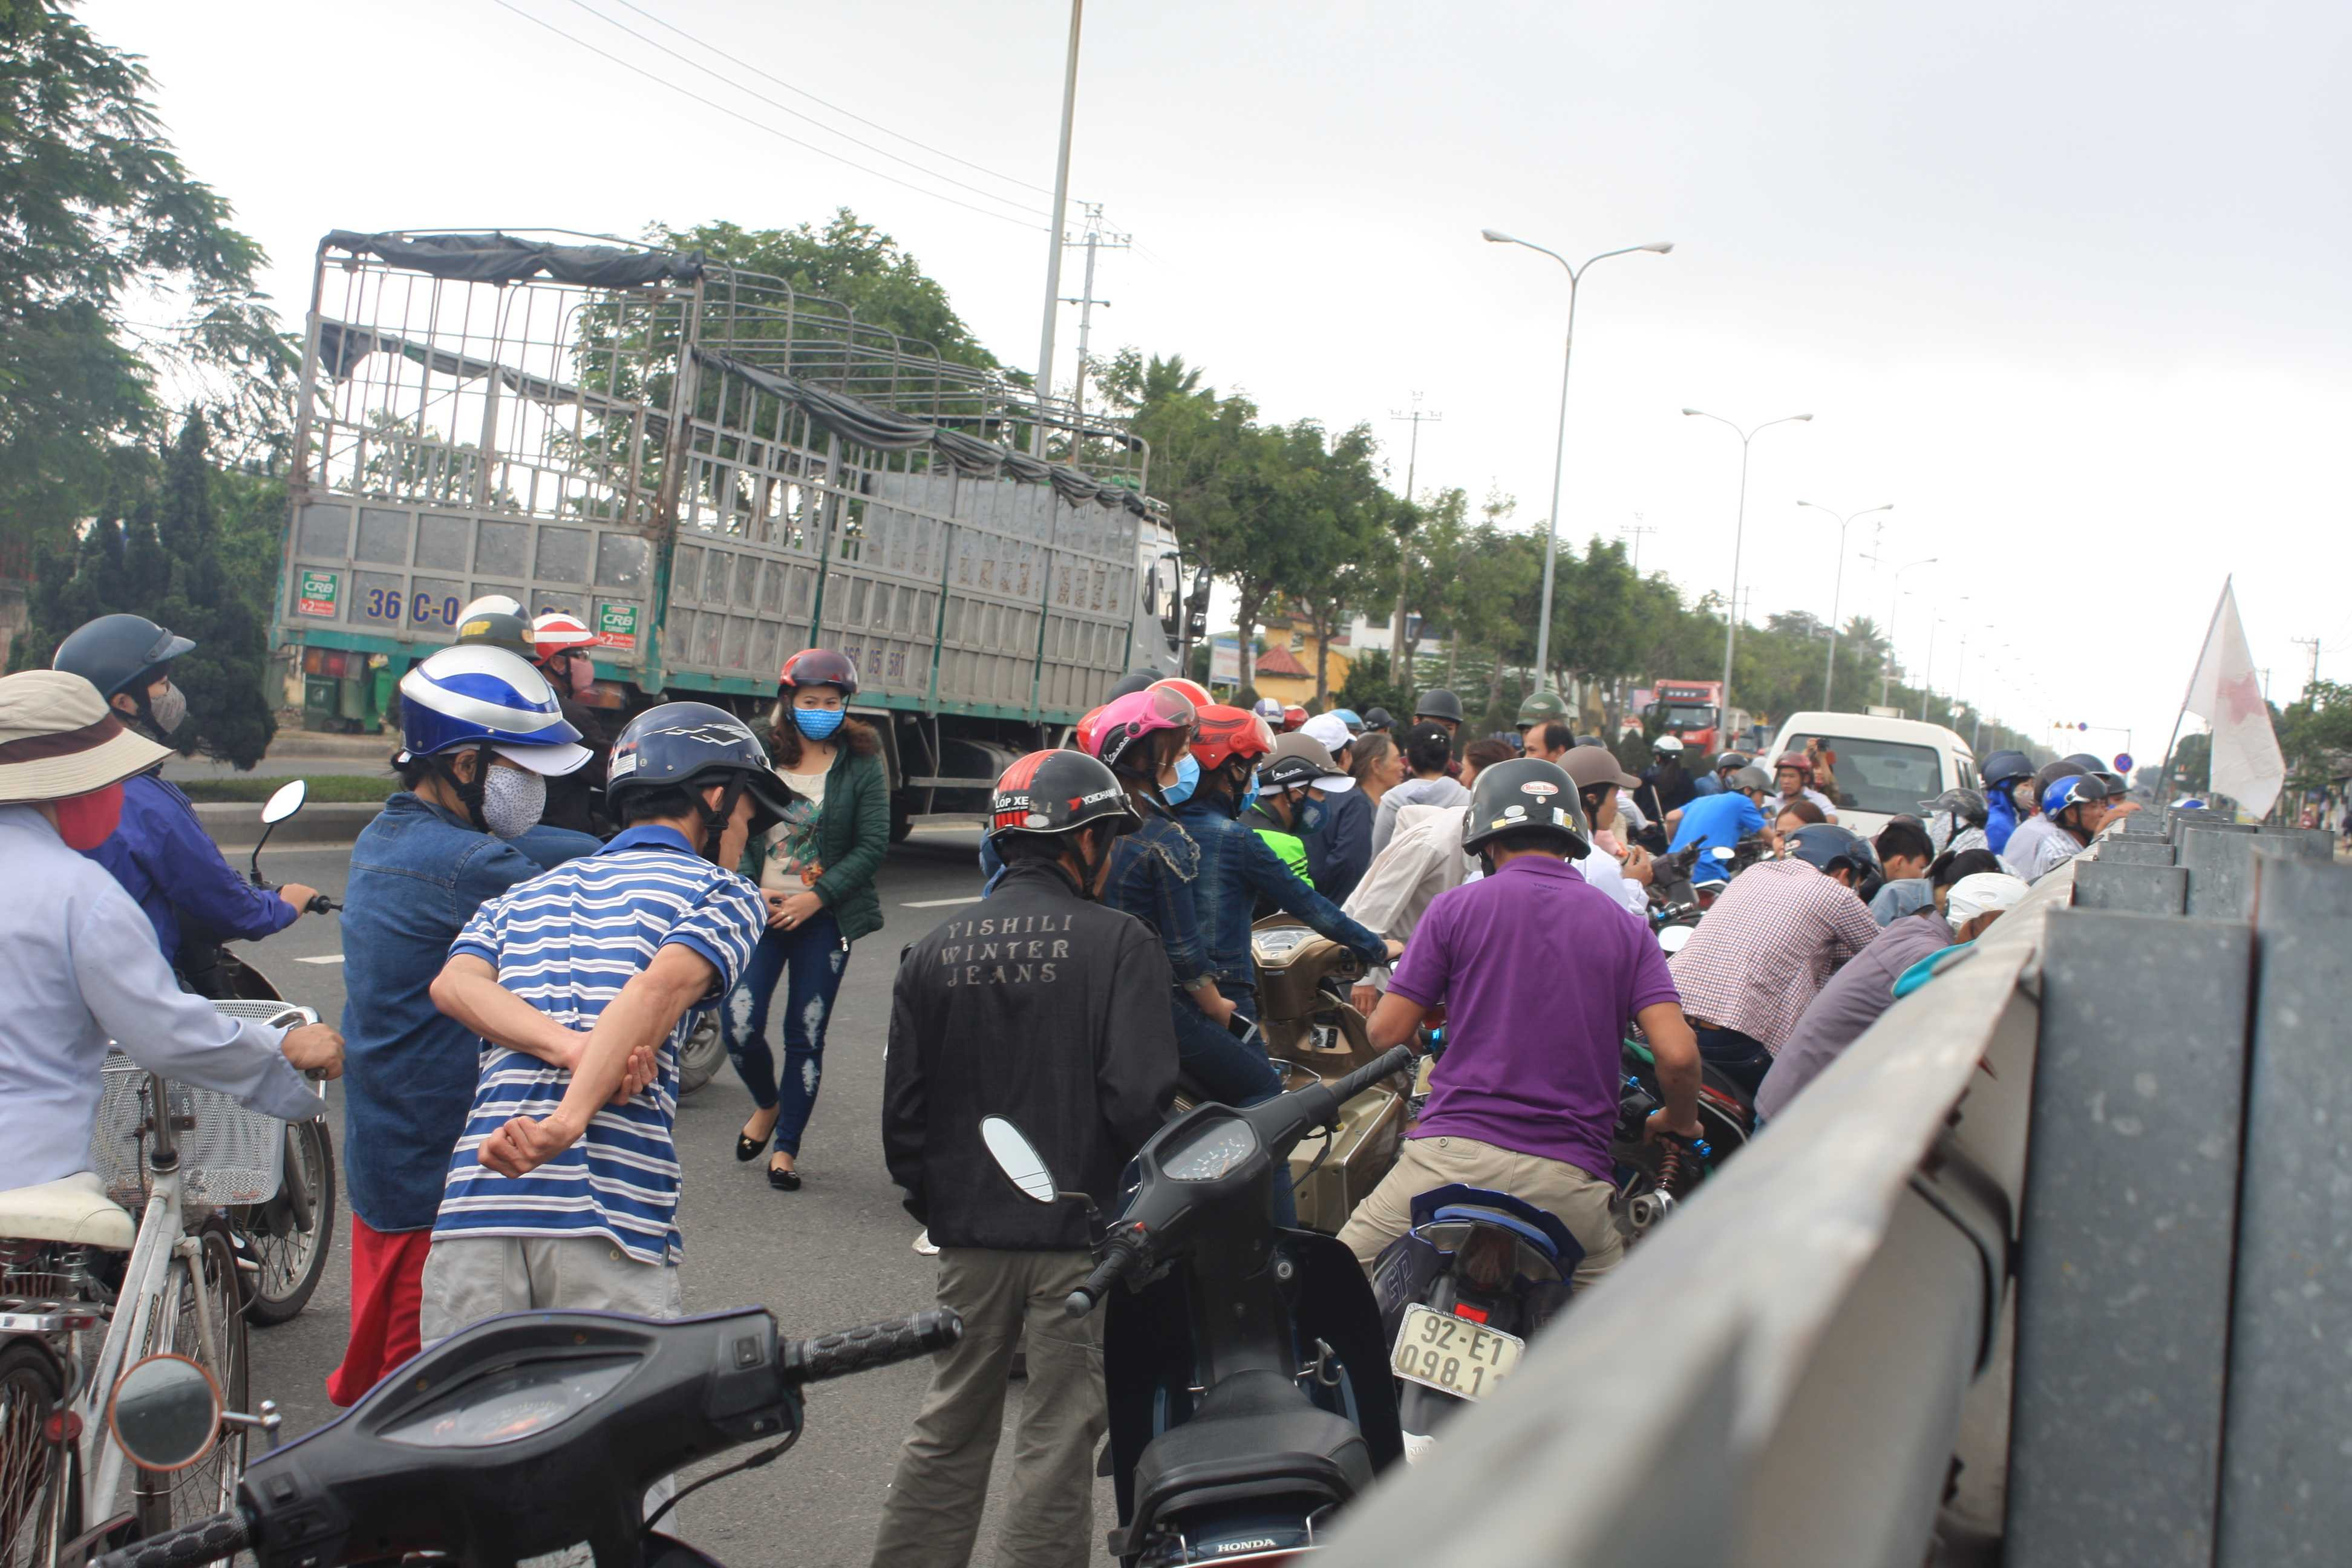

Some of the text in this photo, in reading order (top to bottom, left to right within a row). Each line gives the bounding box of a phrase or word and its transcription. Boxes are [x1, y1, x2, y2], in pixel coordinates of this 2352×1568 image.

[304, 581, 334, 593] CRB
[367, 588, 402, 621] 36
[603, 614, 633, 626] CRB
[1013, 795, 1029, 806] XE
[1082, 788, 1117, 805] YOKOHAMA
[948, 915, 1073, 939] YISHILI
[941, 939, 1070, 965] WINTER
[947, 962, 1057, 987] JEANS
[1420, 1315, 1504, 1366] 92-E1
[1401, 1344, 1505, 1395] 098.1
[1217, 1538, 1276, 1552] HONDA
